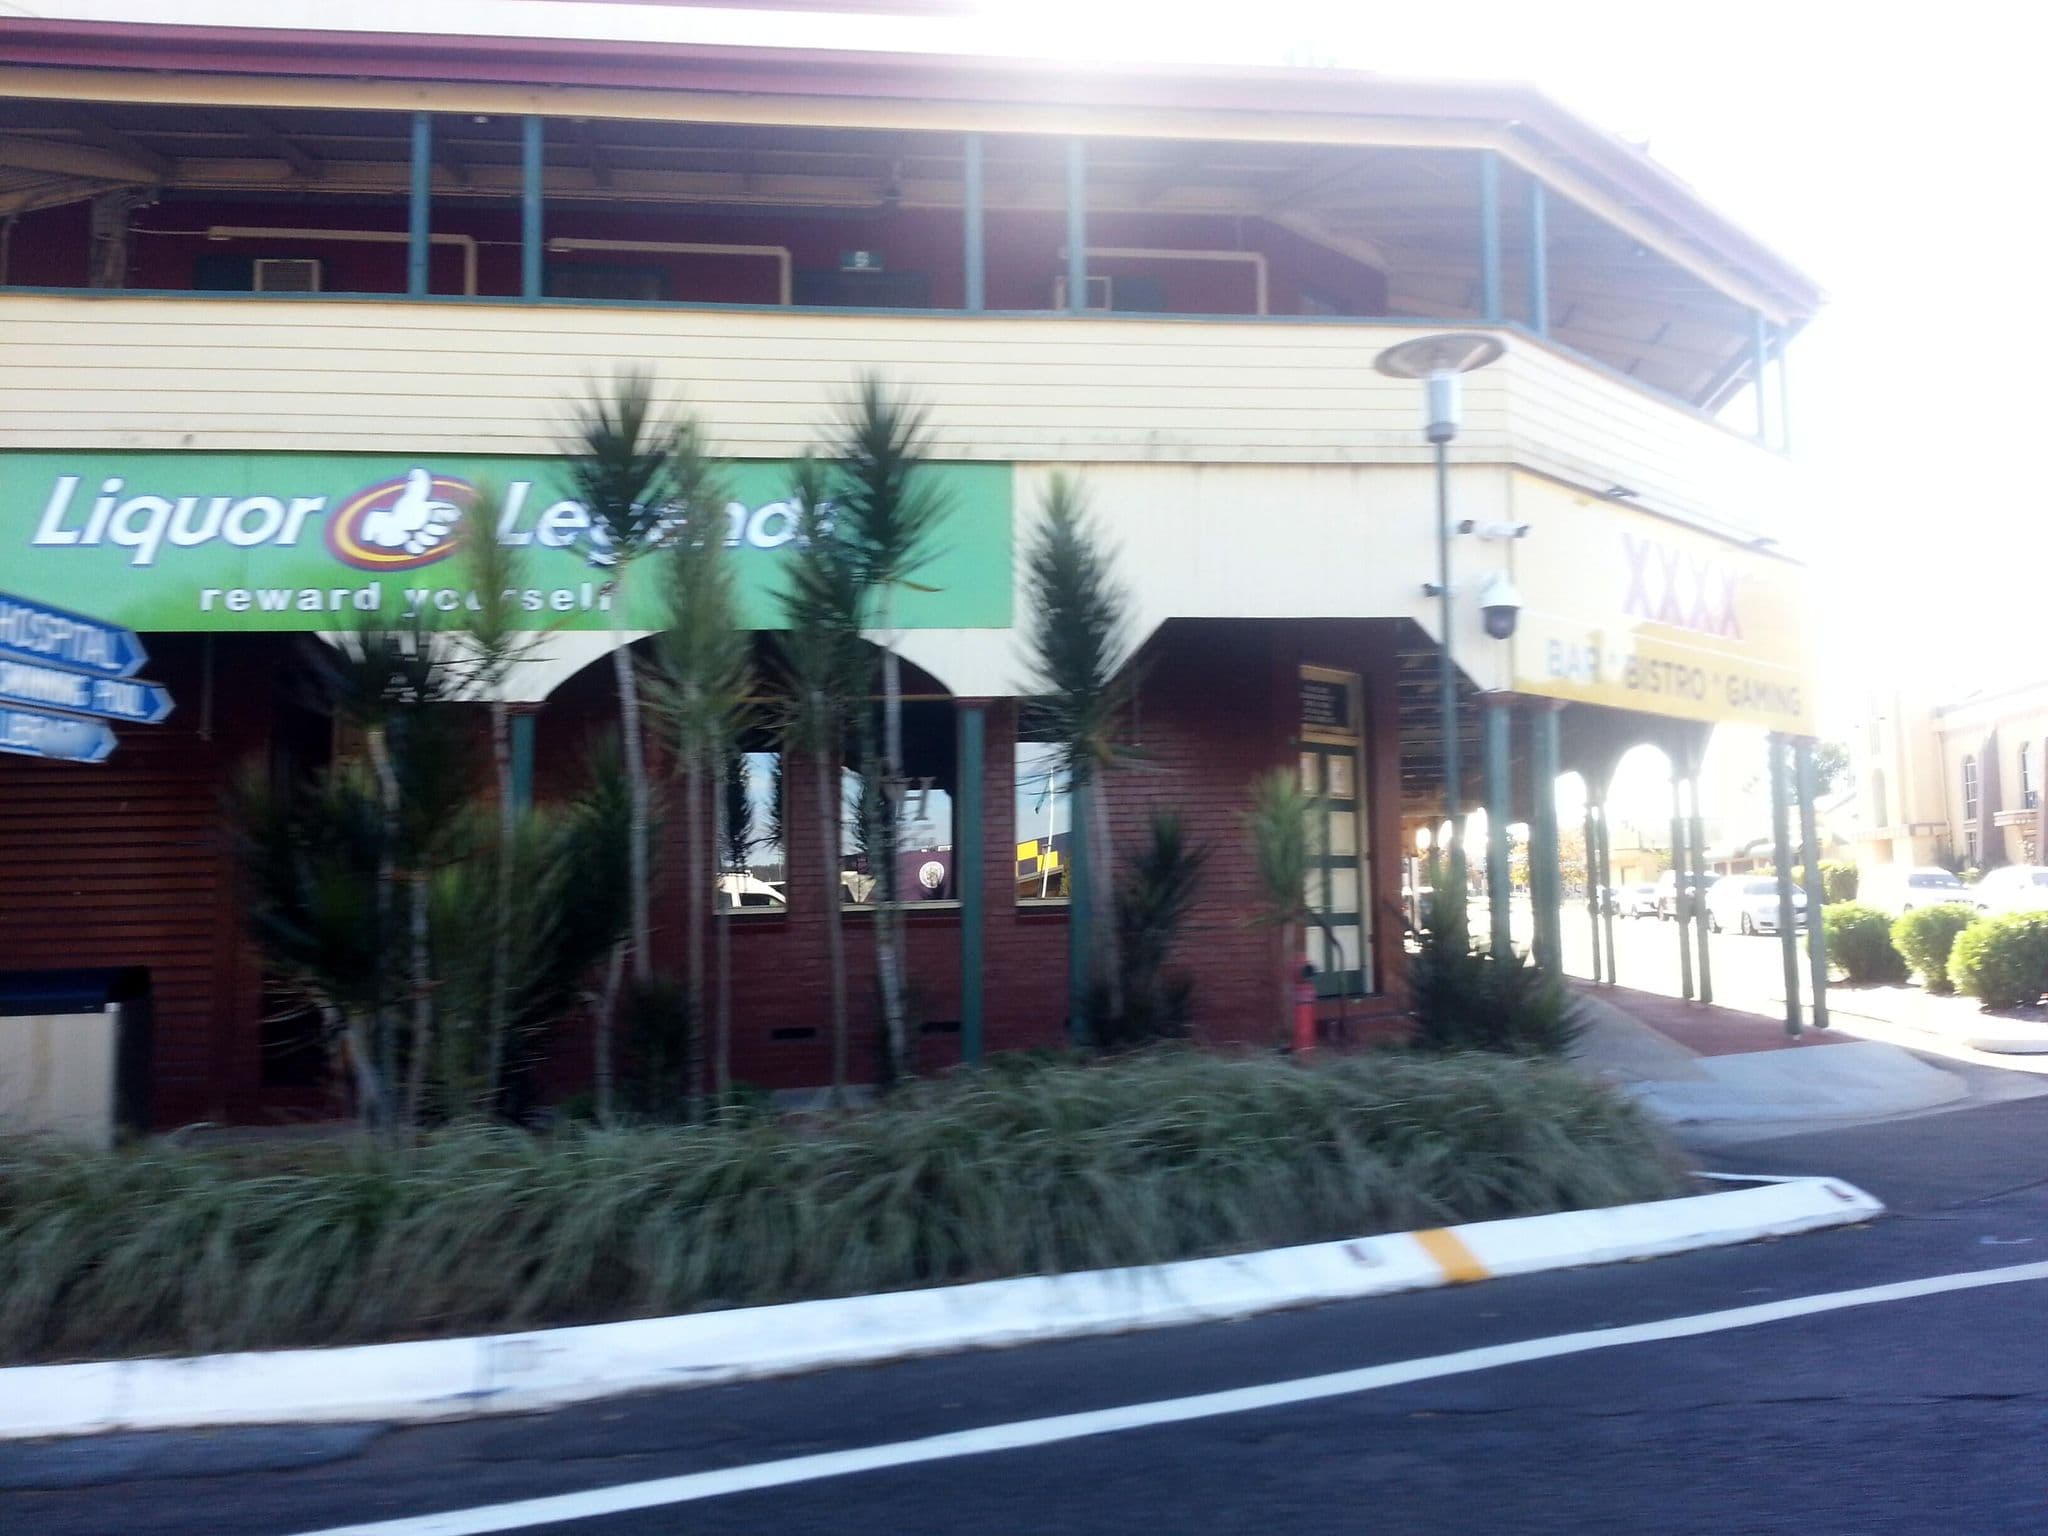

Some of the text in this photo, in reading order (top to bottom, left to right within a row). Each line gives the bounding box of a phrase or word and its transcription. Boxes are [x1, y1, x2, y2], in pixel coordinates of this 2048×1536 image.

[32, 475, 838, 567] Liquor Lend
[201, 582, 381, 612] reward
[1619, 531, 1743, 641] XXXX
[1623, 653, 1706, 702] BISTRO
[1726, 674, 1801, 716] GAMING
